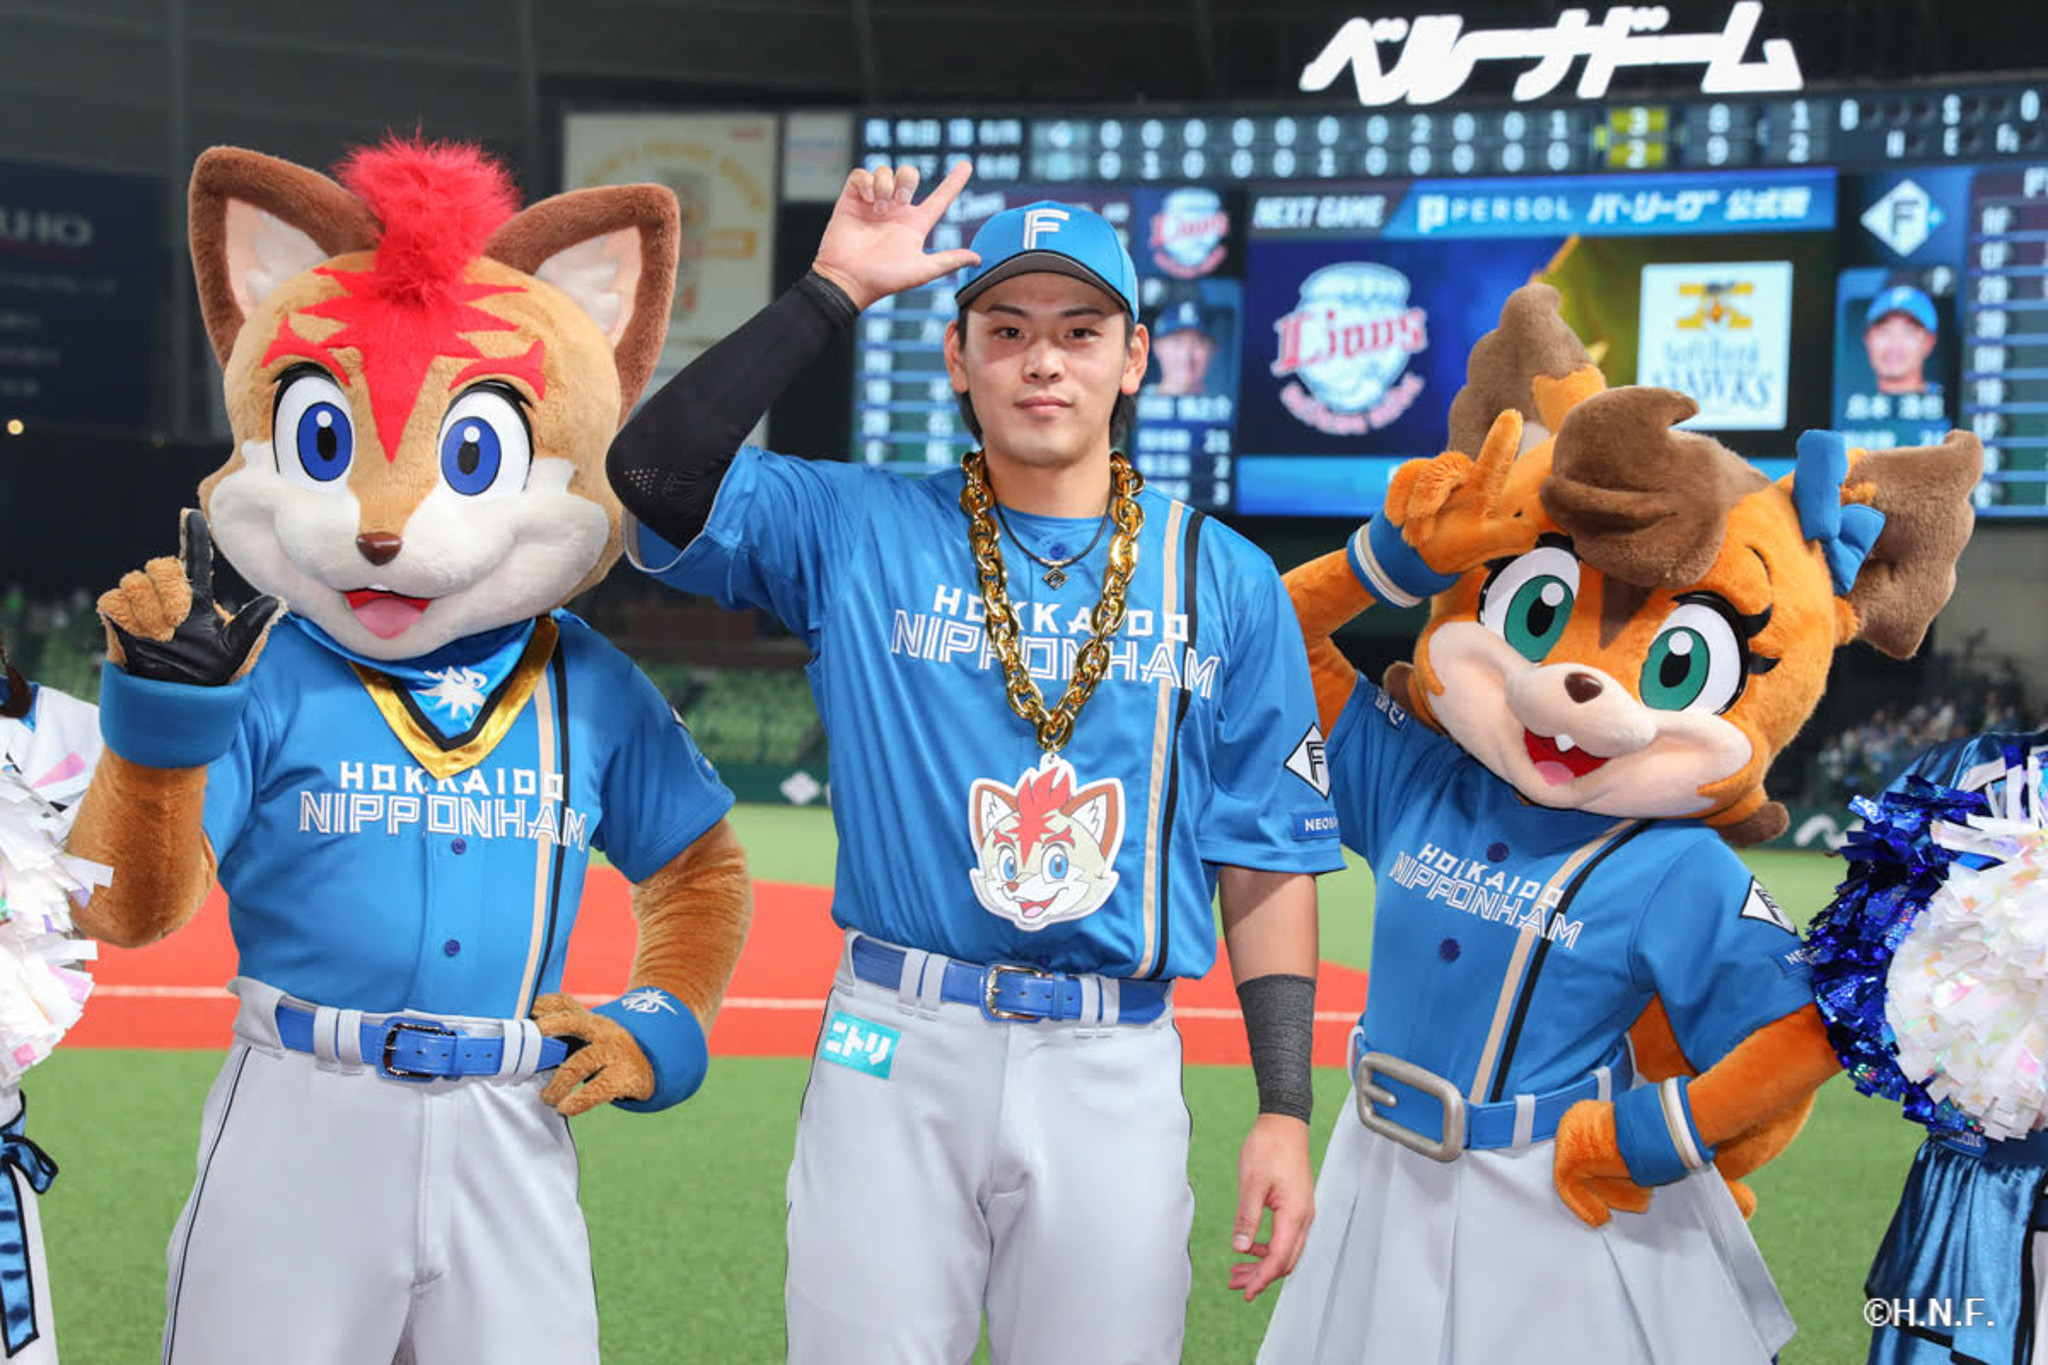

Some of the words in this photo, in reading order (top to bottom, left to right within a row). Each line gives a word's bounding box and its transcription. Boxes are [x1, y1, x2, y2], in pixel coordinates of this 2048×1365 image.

[1024, 208, 1069, 250] F
[1450, 196, 1572, 223] PERSOL
[932, 584, 1189, 642] HOKADO
[1305, 741, 1326, 785] F
[300, 791, 587, 852] NIPPONHAM
[1387, 850, 1585, 950] NIPPONHAM
[825, 1020, 892, 1067] ニトリ
